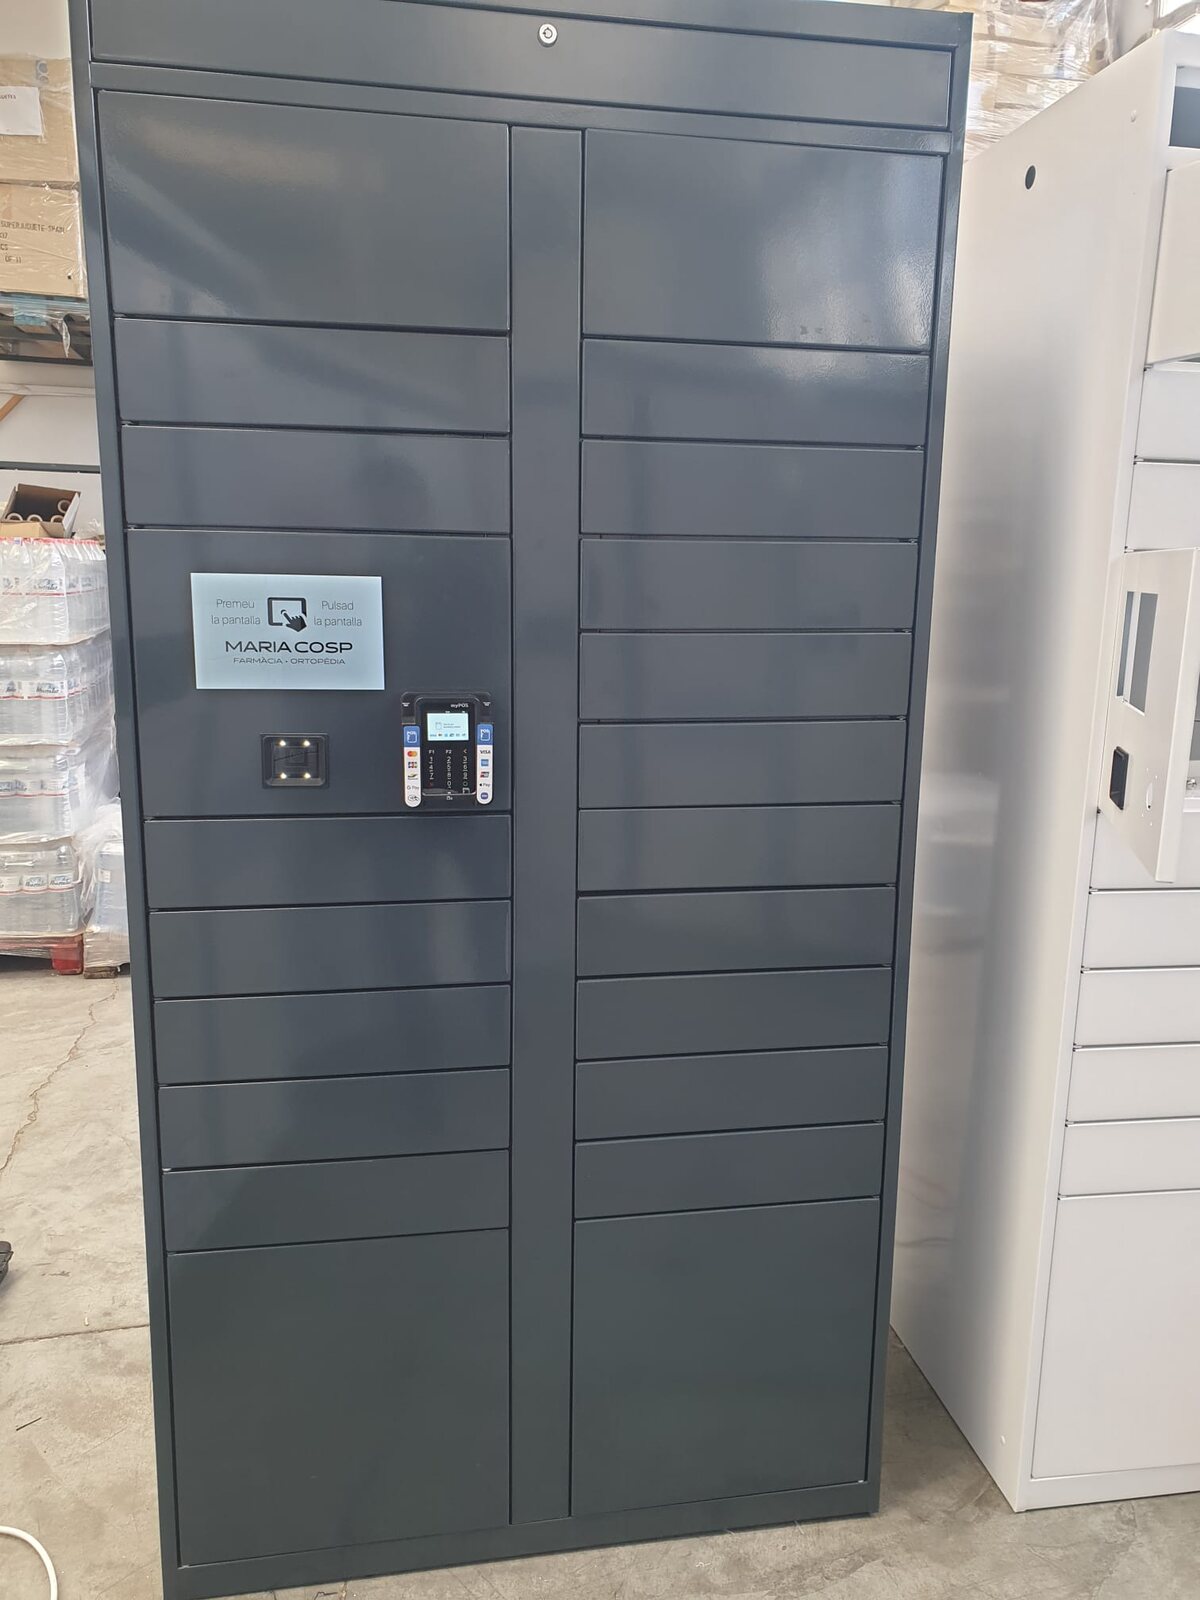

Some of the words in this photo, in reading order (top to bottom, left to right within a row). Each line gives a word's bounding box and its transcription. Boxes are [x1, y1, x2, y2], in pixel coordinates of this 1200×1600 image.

[216, 599, 255, 609] Premeu
[321, 600, 354, 611] Pulsad
[211, 616, 220, 625] la
[222, 616, 261, 627] pantalla
[314, 617, 322, 626] la
[325, 617, 362, 628] pantalla
[225, 641, 291, 653] MARIA
[295, 642, 353, 654] COSP
